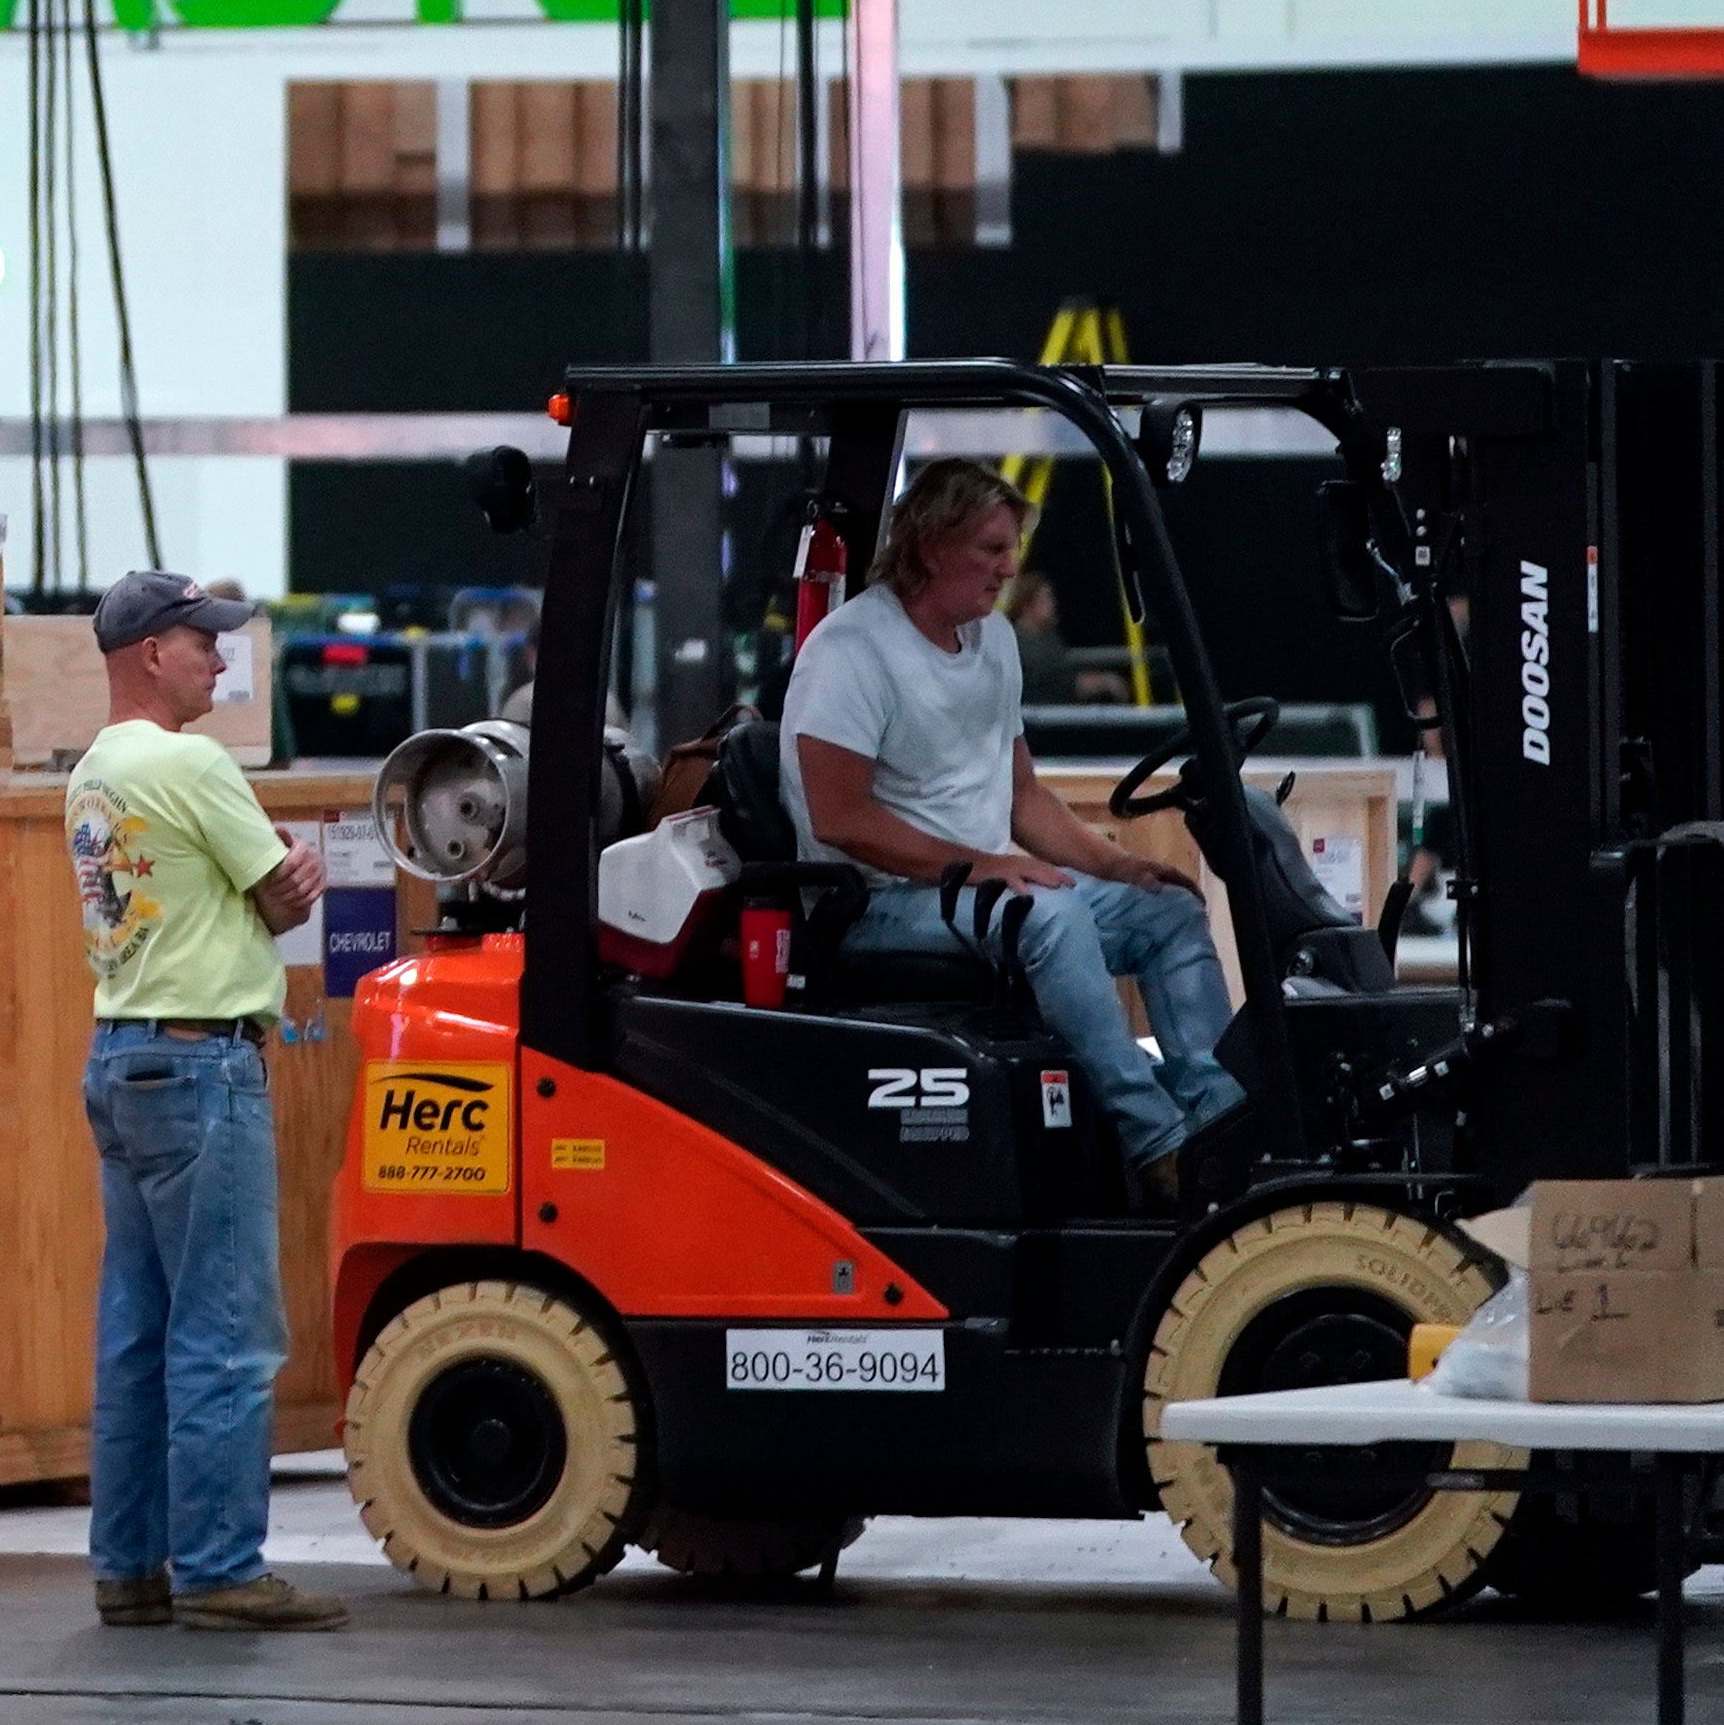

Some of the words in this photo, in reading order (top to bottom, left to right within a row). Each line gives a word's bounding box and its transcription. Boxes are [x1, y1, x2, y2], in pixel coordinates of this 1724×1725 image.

[1519, 559, 1550, 767] DOOSAN
[328, 930, 392, 955] CHEVROLET
[867, 1067, 971, 1109] 25
[379, 1089, 490, 1132] Herc
[405, 1135, 482, 1157] Rentals
[377, 1164, 487, 1182] 888-777-2700
[731, 1351, 940, 1384] 800-36-9094
